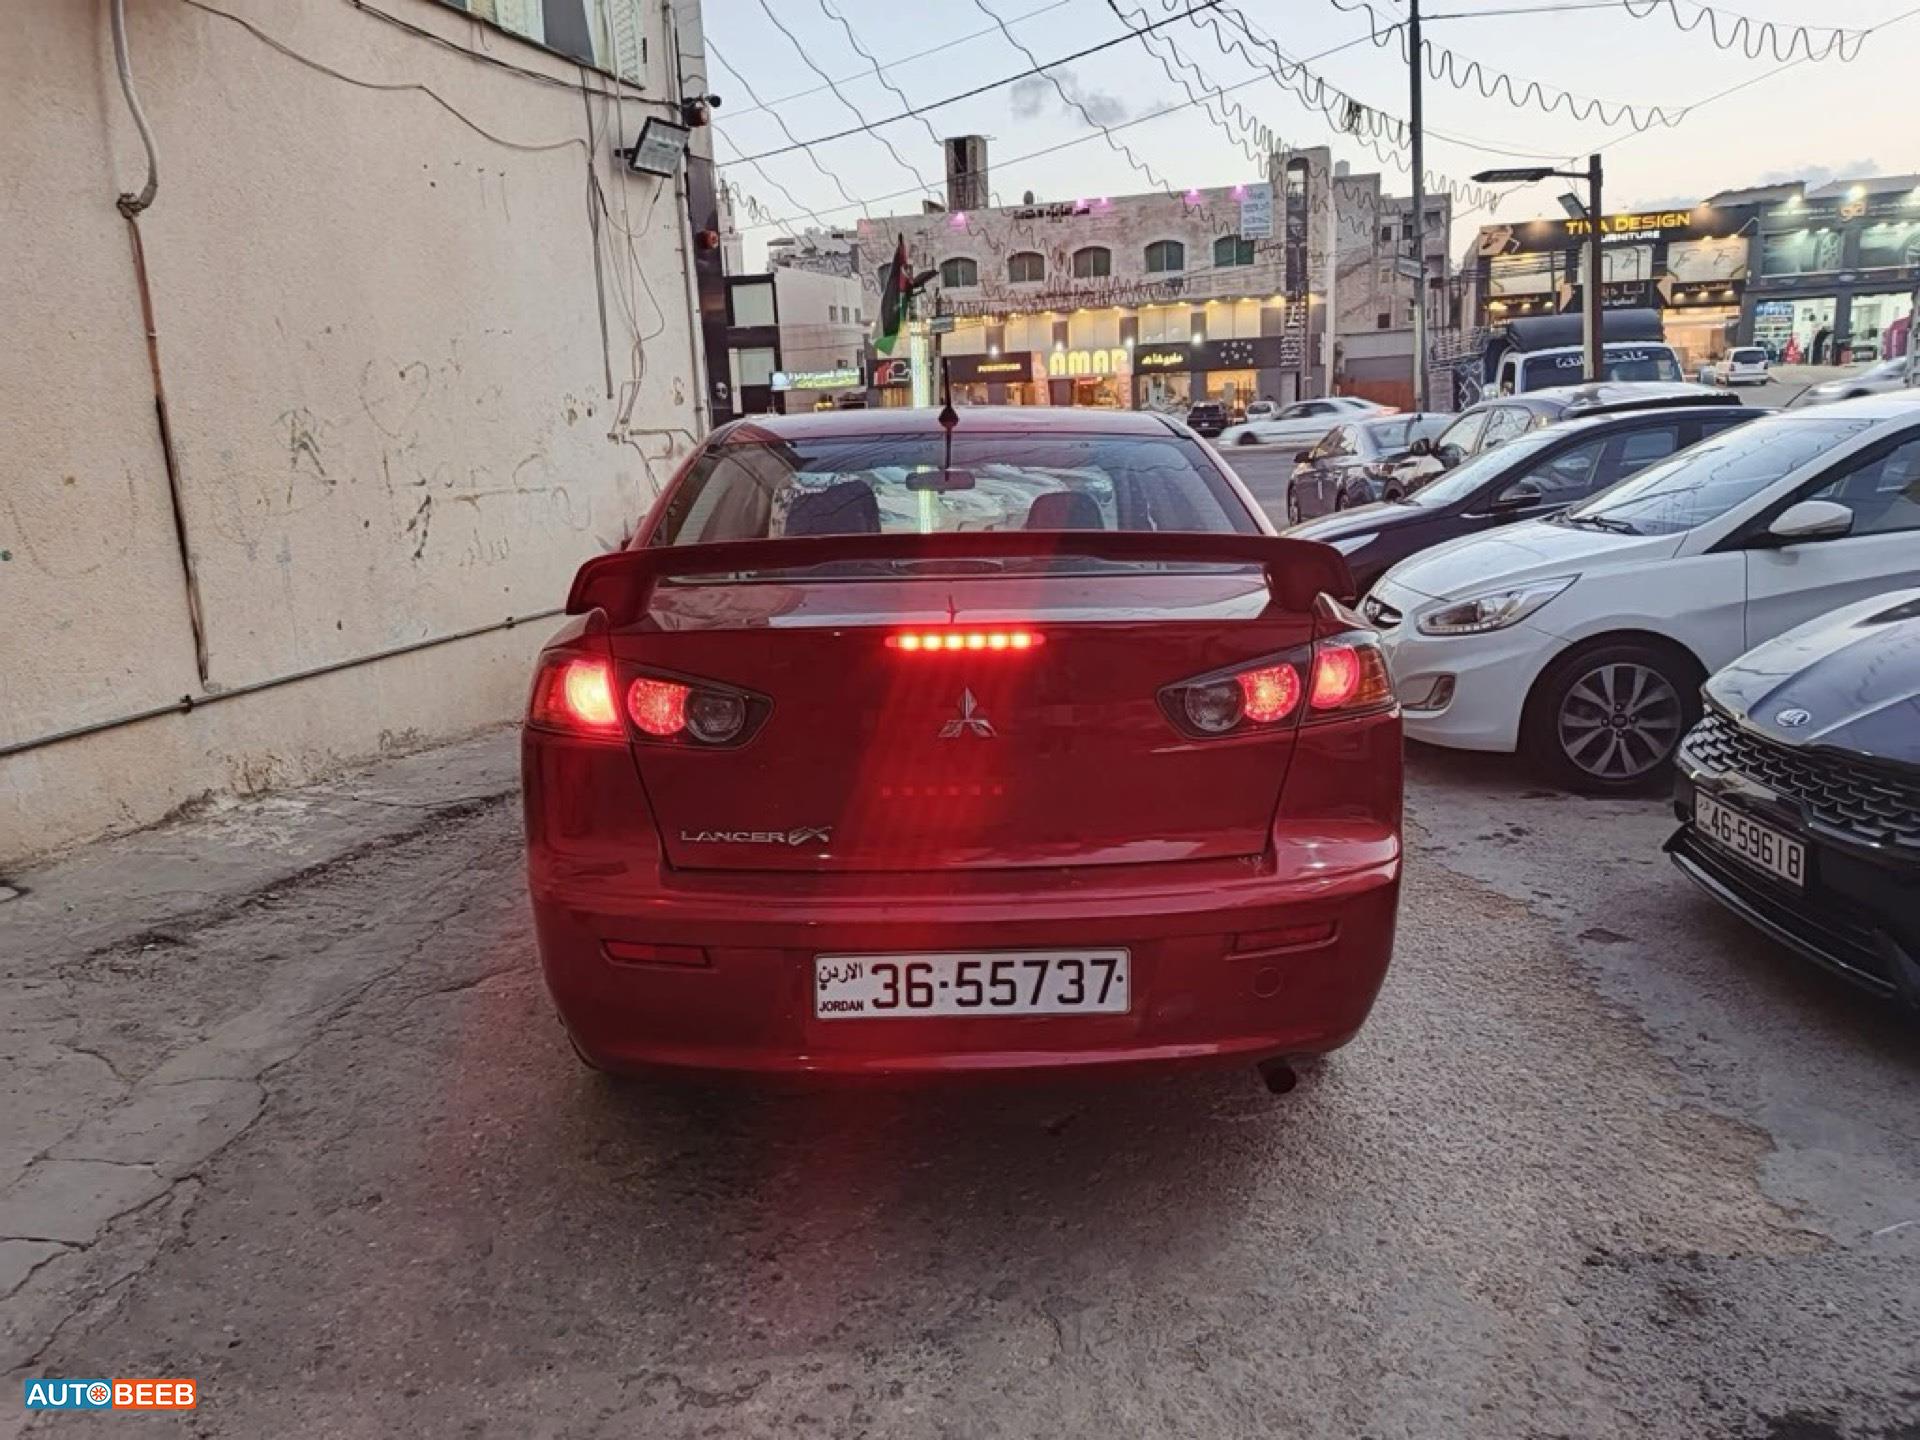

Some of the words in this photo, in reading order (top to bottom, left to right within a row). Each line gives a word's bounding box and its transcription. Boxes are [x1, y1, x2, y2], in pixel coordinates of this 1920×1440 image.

[1615, 212, 1690, 231] DESIGN
[1600, 230, 1660, 242] URNITURE
[681, 830, 785, 843] LANCER
[788, 825, 832, 846] EX
[818, 1000, 864, 1013] JORDAN
